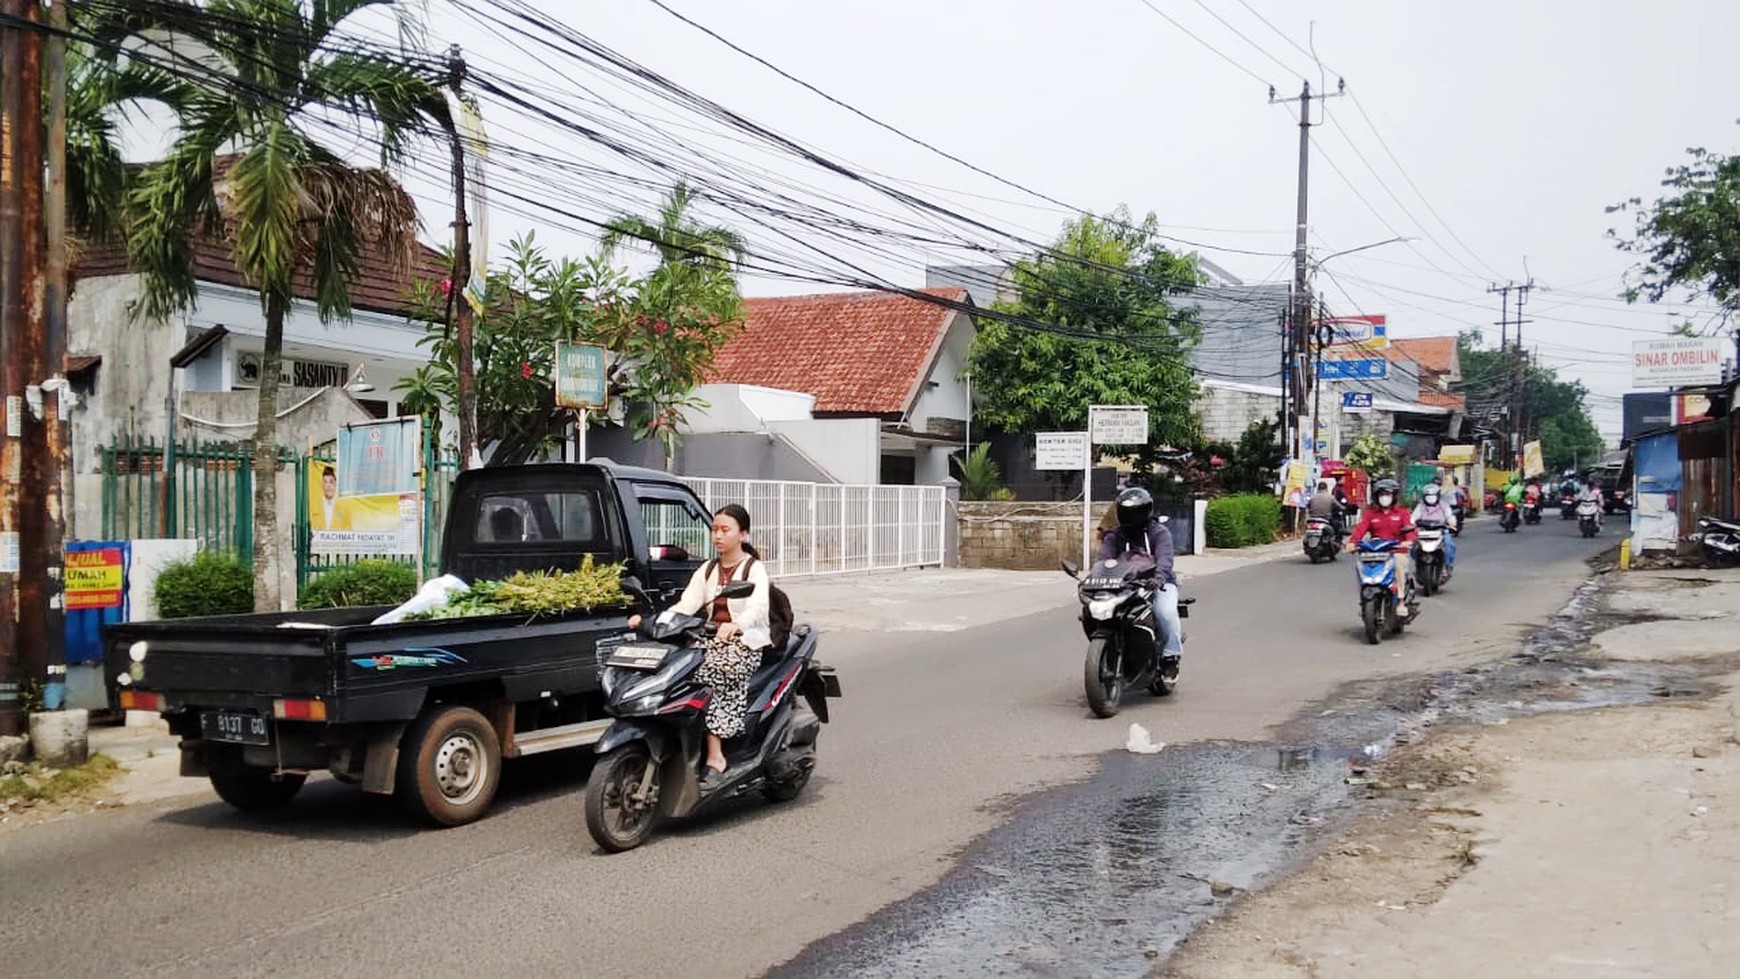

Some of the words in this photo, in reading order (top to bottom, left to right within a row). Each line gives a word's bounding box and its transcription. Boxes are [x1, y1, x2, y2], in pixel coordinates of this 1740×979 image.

[1635, 352, 1668, 368] SINAR
[1672, 348, 1718, 365] OMBILIN
[294, 361, 338, 388] SASANTY
[320, 532, 355, 541] RACHMAT
[66, 569, 106, 581] UMAH
